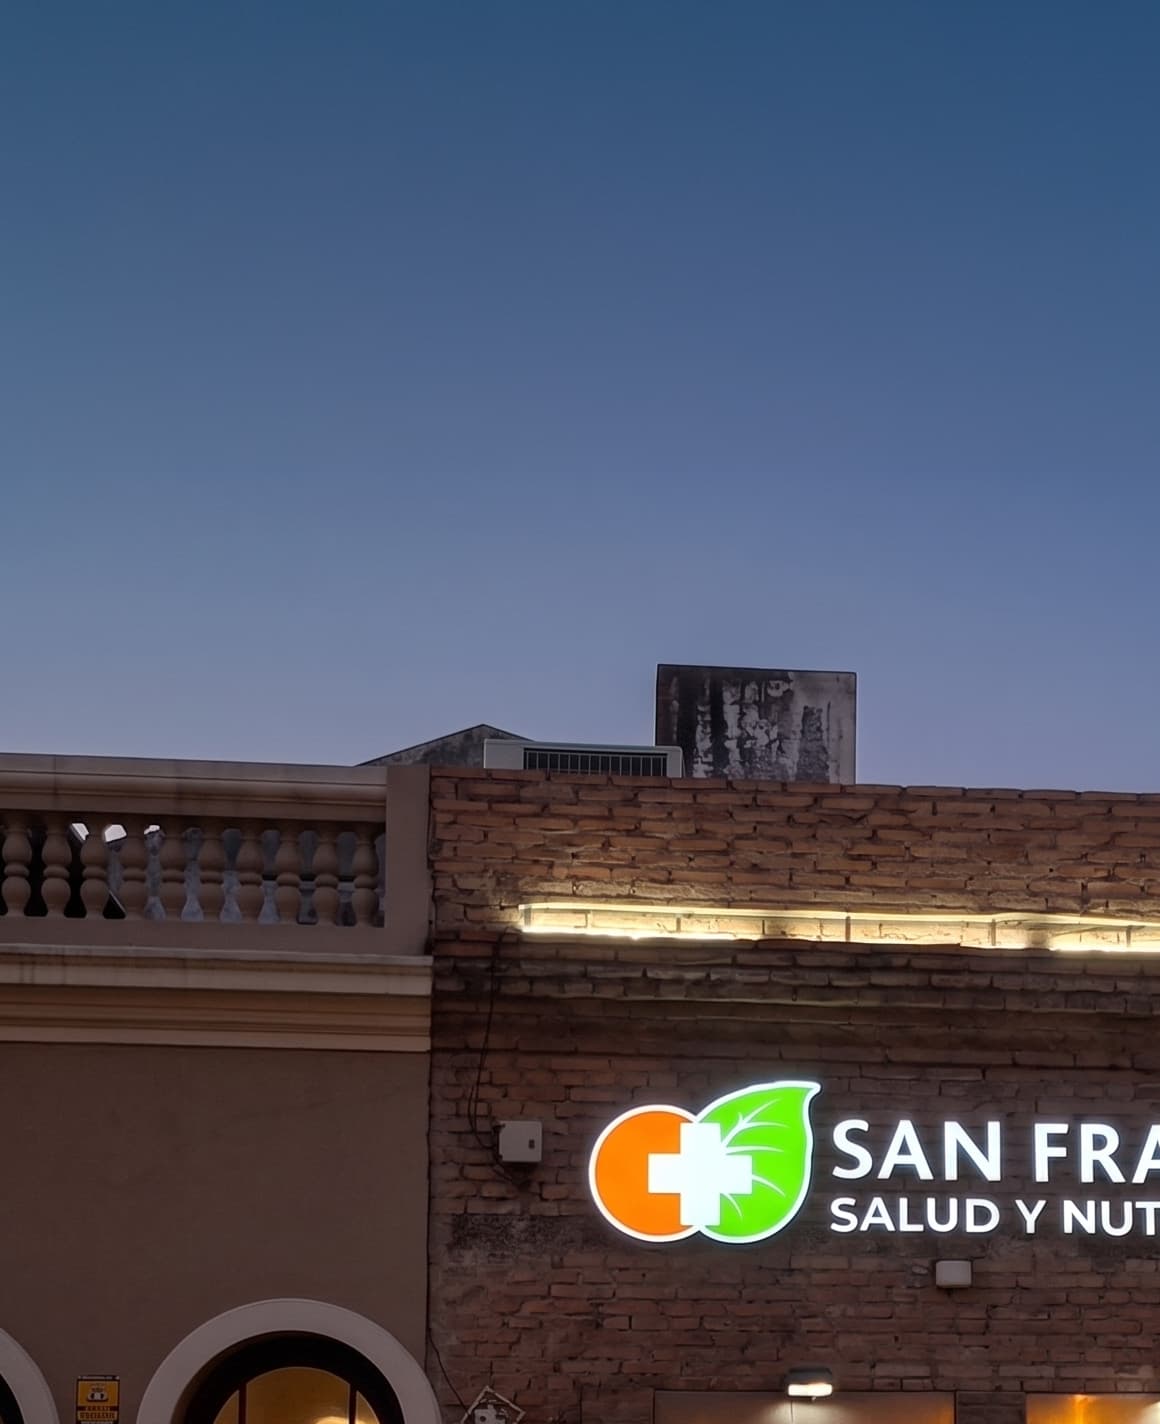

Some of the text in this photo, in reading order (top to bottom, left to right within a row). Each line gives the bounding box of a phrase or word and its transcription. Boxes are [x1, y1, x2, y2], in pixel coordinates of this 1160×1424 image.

[832, 1118, 1001, 1182] SAN
[830, 1197, 1001, 1234] SALUD
[1015, 1199, 1048, 1235] Y
